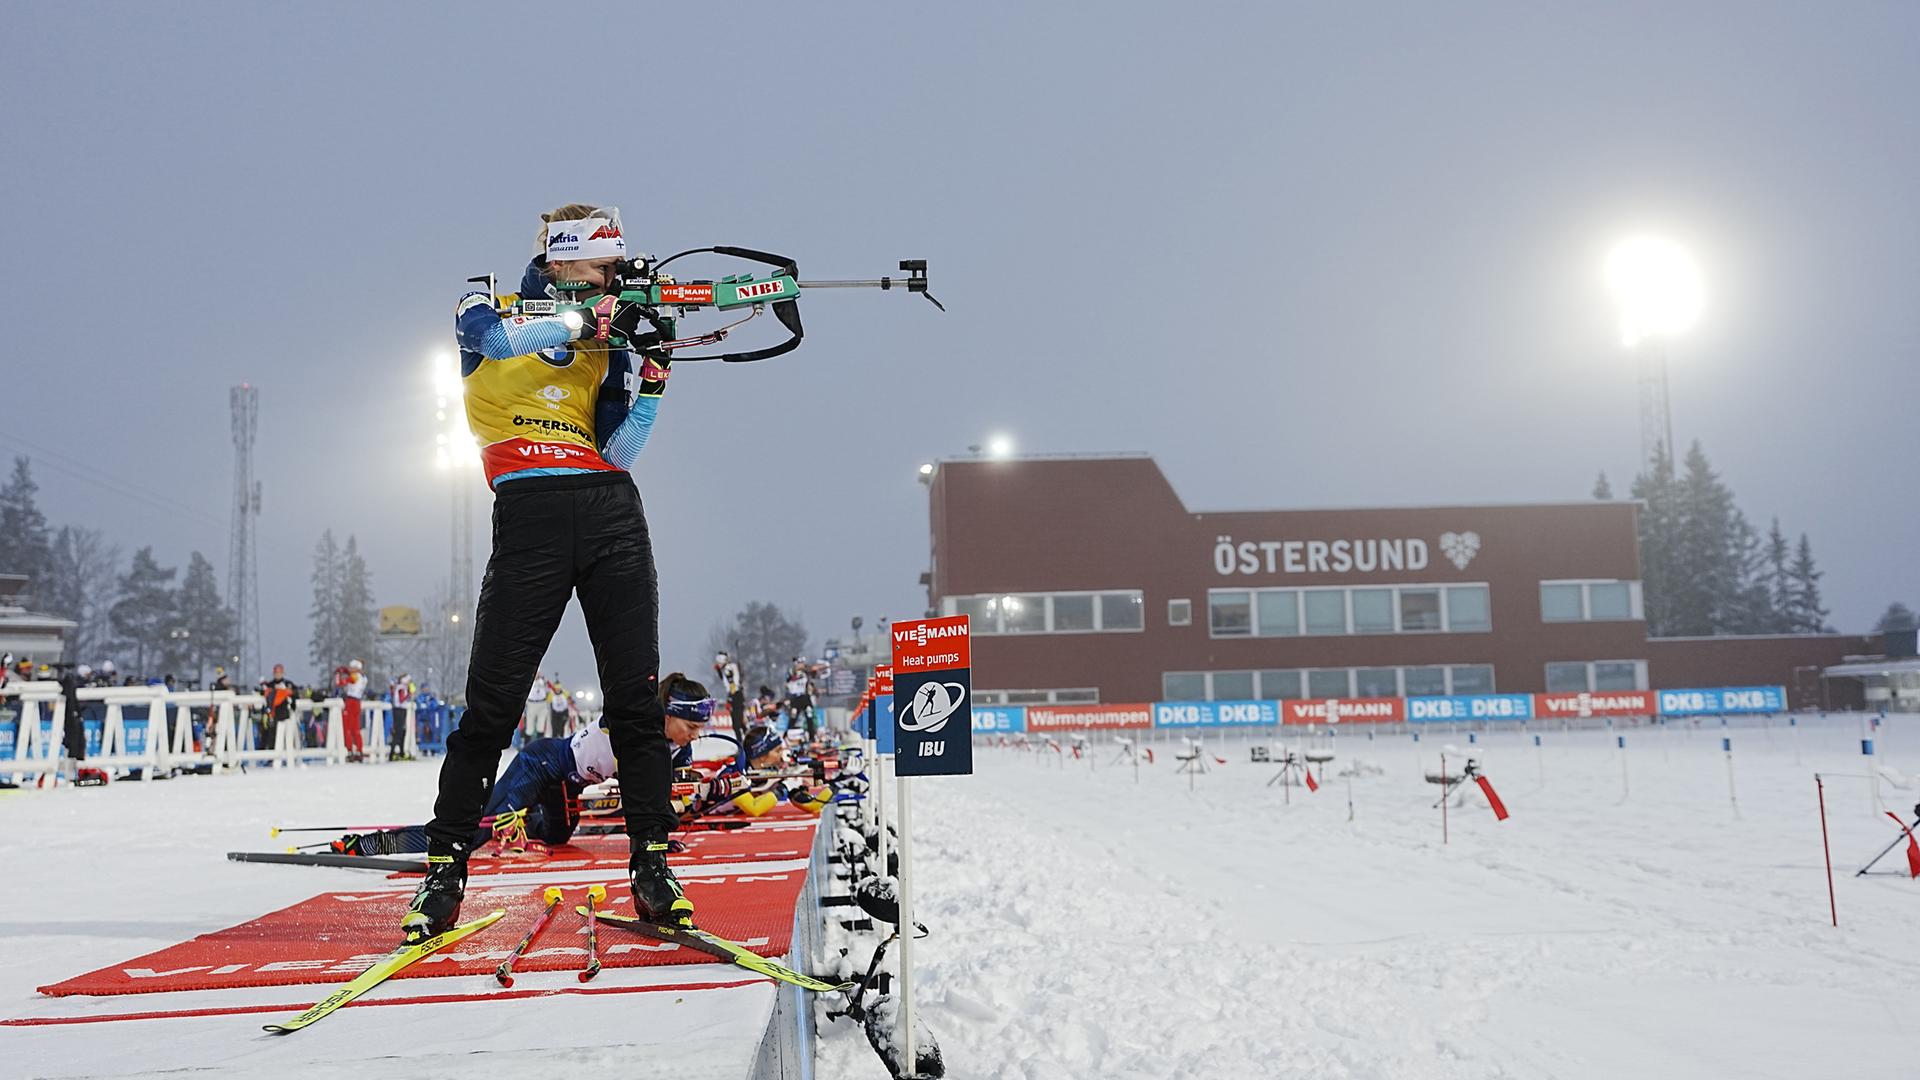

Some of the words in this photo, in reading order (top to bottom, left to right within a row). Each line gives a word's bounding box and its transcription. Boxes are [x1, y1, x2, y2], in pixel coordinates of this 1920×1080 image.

[661, 287, 712, 299] VIESSMANN
[738, 282, 783, 298] NIBE
[1214, 535, 1429, 575] ÖSTERSUND
[894, 624, 968, 646] VIESSMANN
[903, 654, 925, 666] Heat
[927, 652, 960, 667] pumps
[1411, 700, 1454, 718] DKB
[1472, 698, 1513, 717] DKB
[1546, 693, 1645, 717] VIESSMANN
[1663, 692, 1705, 711] DKB
[1723, 690, 1765, 709] DKB
[1029, 710, 1149, 727] Wärmepumpen
[1159, 705, 1200, 724] DKB
[1220, 704, 1261, 722] DKB
[1293, 699, 1393, 722] VIESSMANN
[972, 711, 996, 729] KB
[918, 740, 945, 757] IBU
[595, 799, 618, 808] ATG
[420, 936, 444, 954] FISCHER
